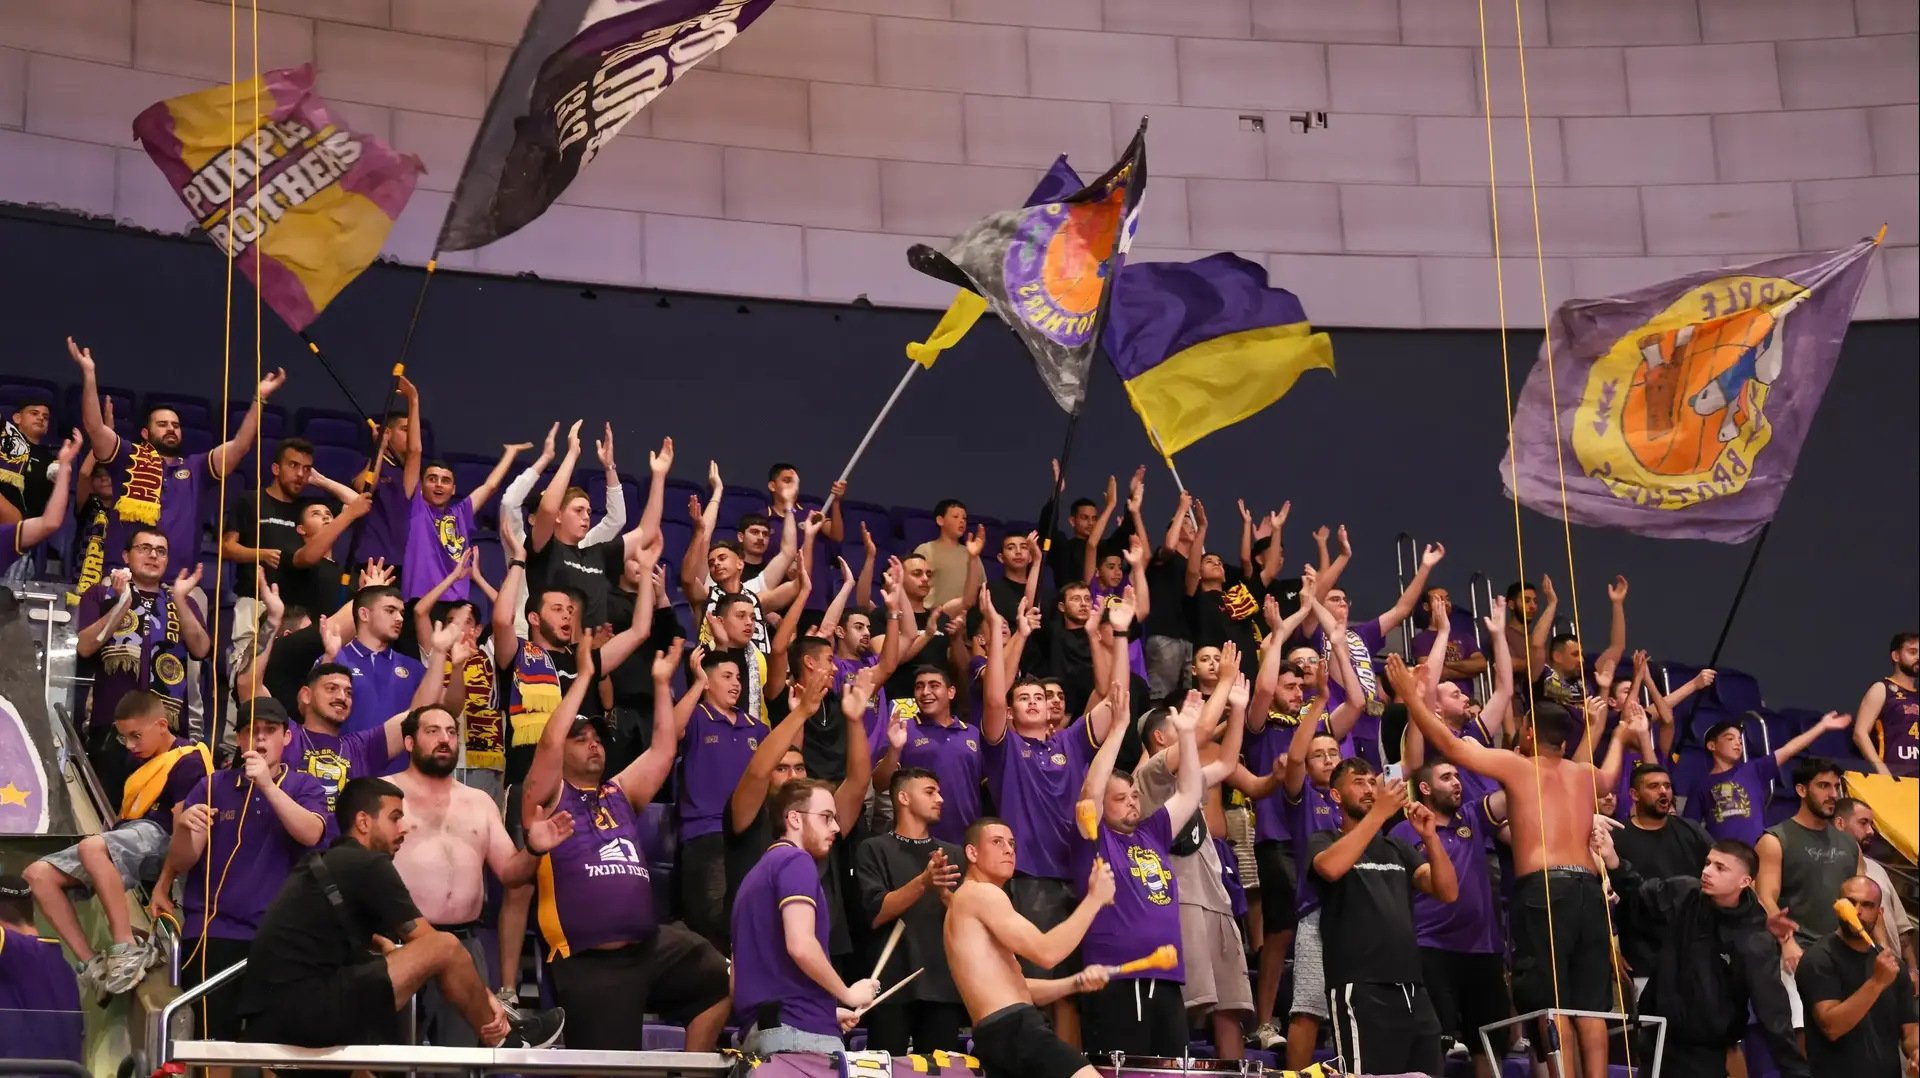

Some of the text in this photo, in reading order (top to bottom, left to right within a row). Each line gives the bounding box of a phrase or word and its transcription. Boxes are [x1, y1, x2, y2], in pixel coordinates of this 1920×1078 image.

[206, 131, 363, 258] ROTHERS
[77, 536, 105, 594] PURP
[595, 806, 619, 830] 21
[584, 863, 626, 878] נתנאל
